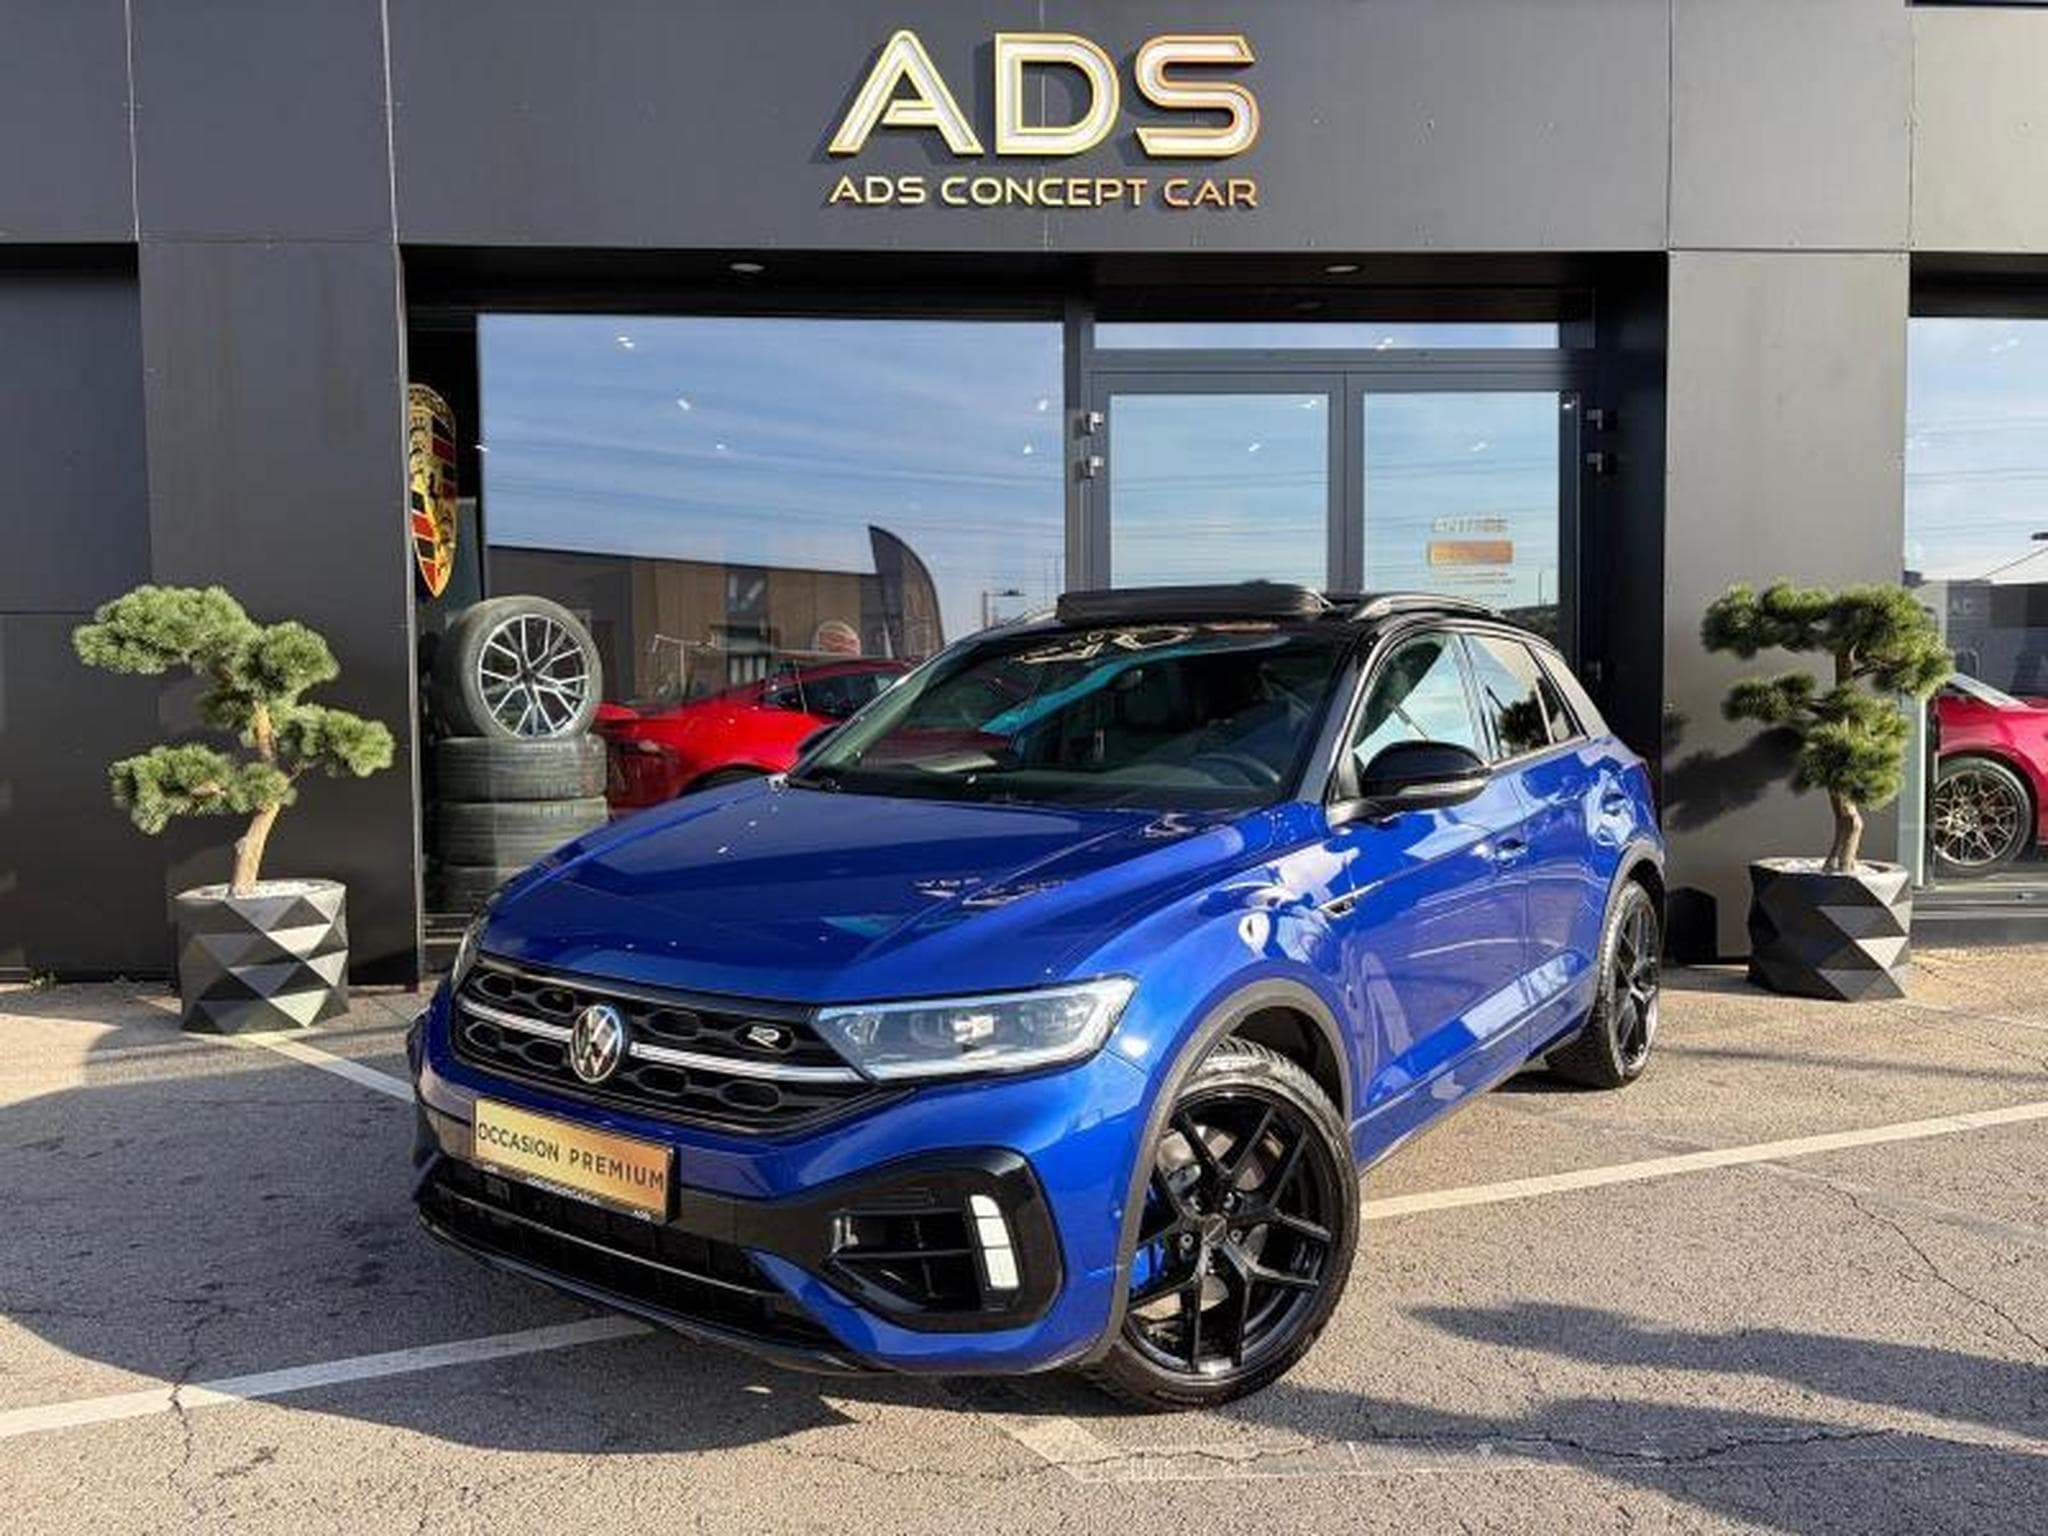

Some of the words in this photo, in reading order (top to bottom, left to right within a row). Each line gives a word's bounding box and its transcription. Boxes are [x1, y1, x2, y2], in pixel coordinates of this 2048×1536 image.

[828, 29, 1260, 159] ADS
[829, 175, 927, 207] ADS
[940, 176, 1148, 207] CONCEPT
[1163, 178, 1258, 208] CAR
[477, 1122, 560, 1163] OCCASION
[569, 1148, 664, 1191] PREMIUM
